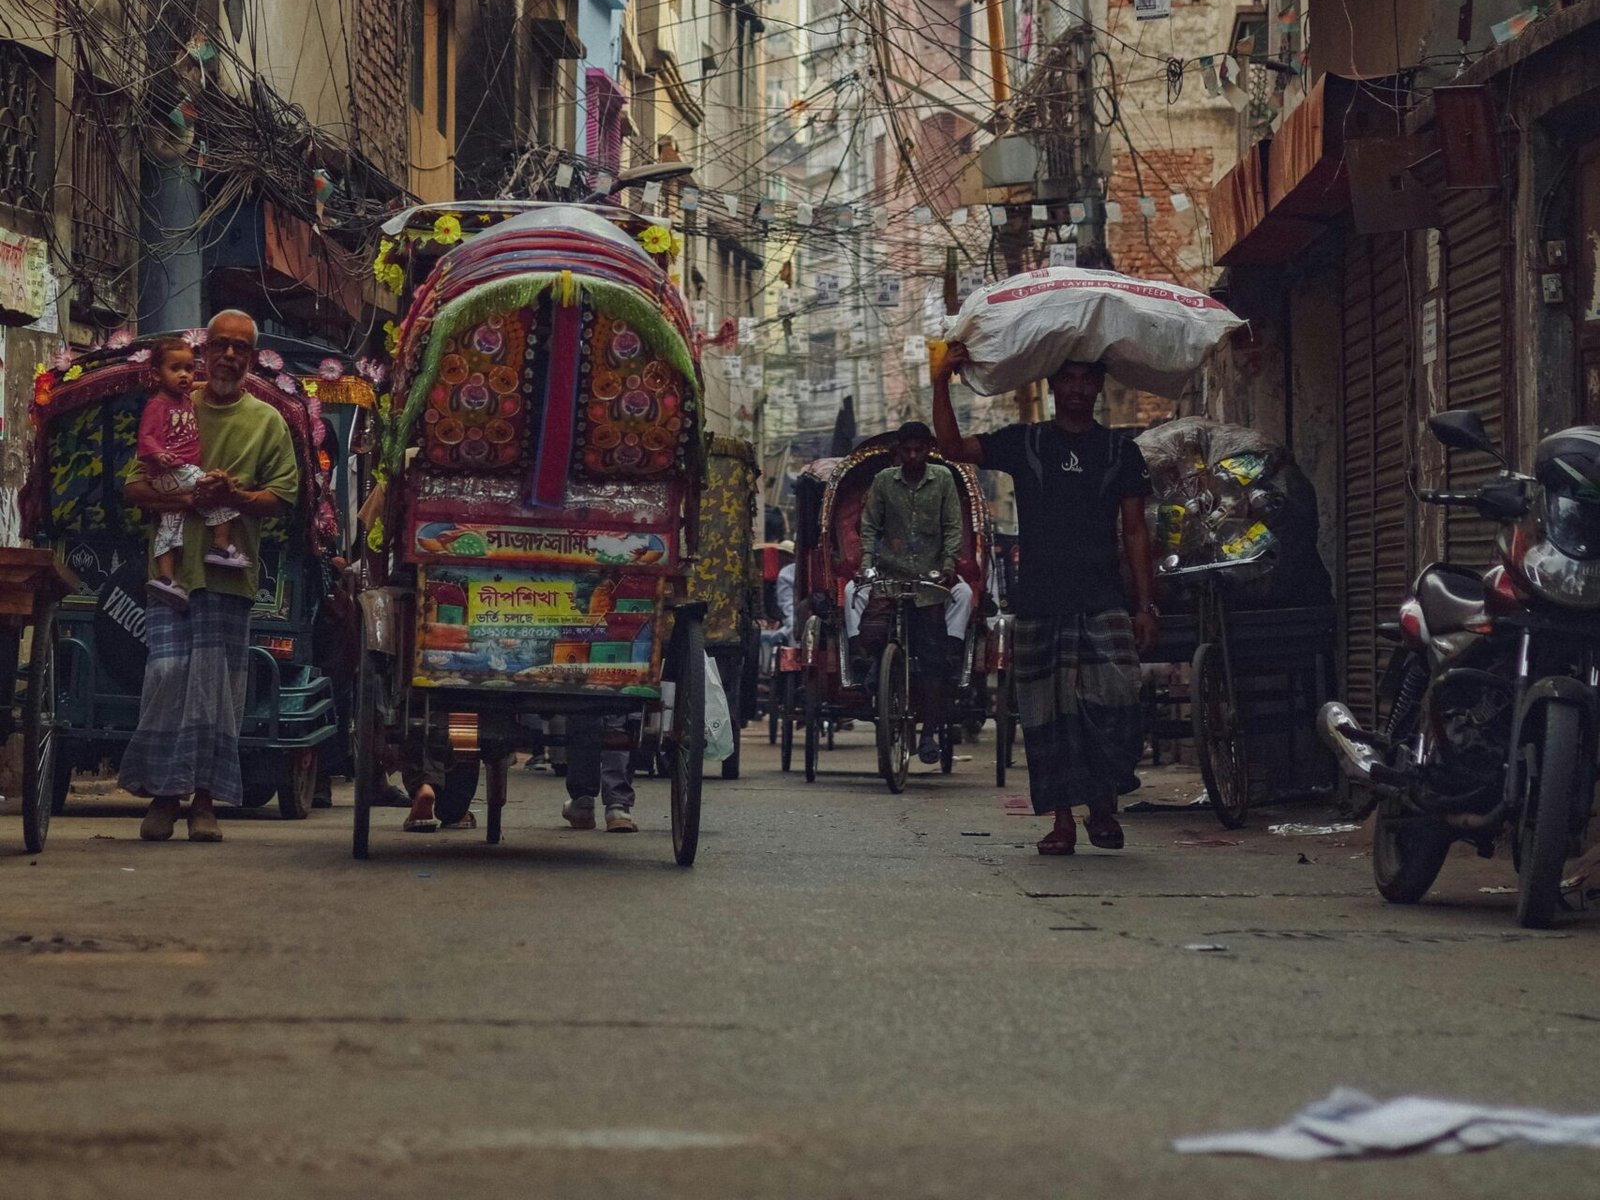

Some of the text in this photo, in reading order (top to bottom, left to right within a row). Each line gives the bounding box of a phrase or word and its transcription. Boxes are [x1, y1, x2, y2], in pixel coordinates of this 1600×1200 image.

[1142, 287, 1168, 297] FEED
[477, 585, 560, 608] দীপশিখা
[103, 586, 149, 647] ODINA
[476, 610, 500, 623] ভর্তি
[503, 613, 534, 624] চলছে
